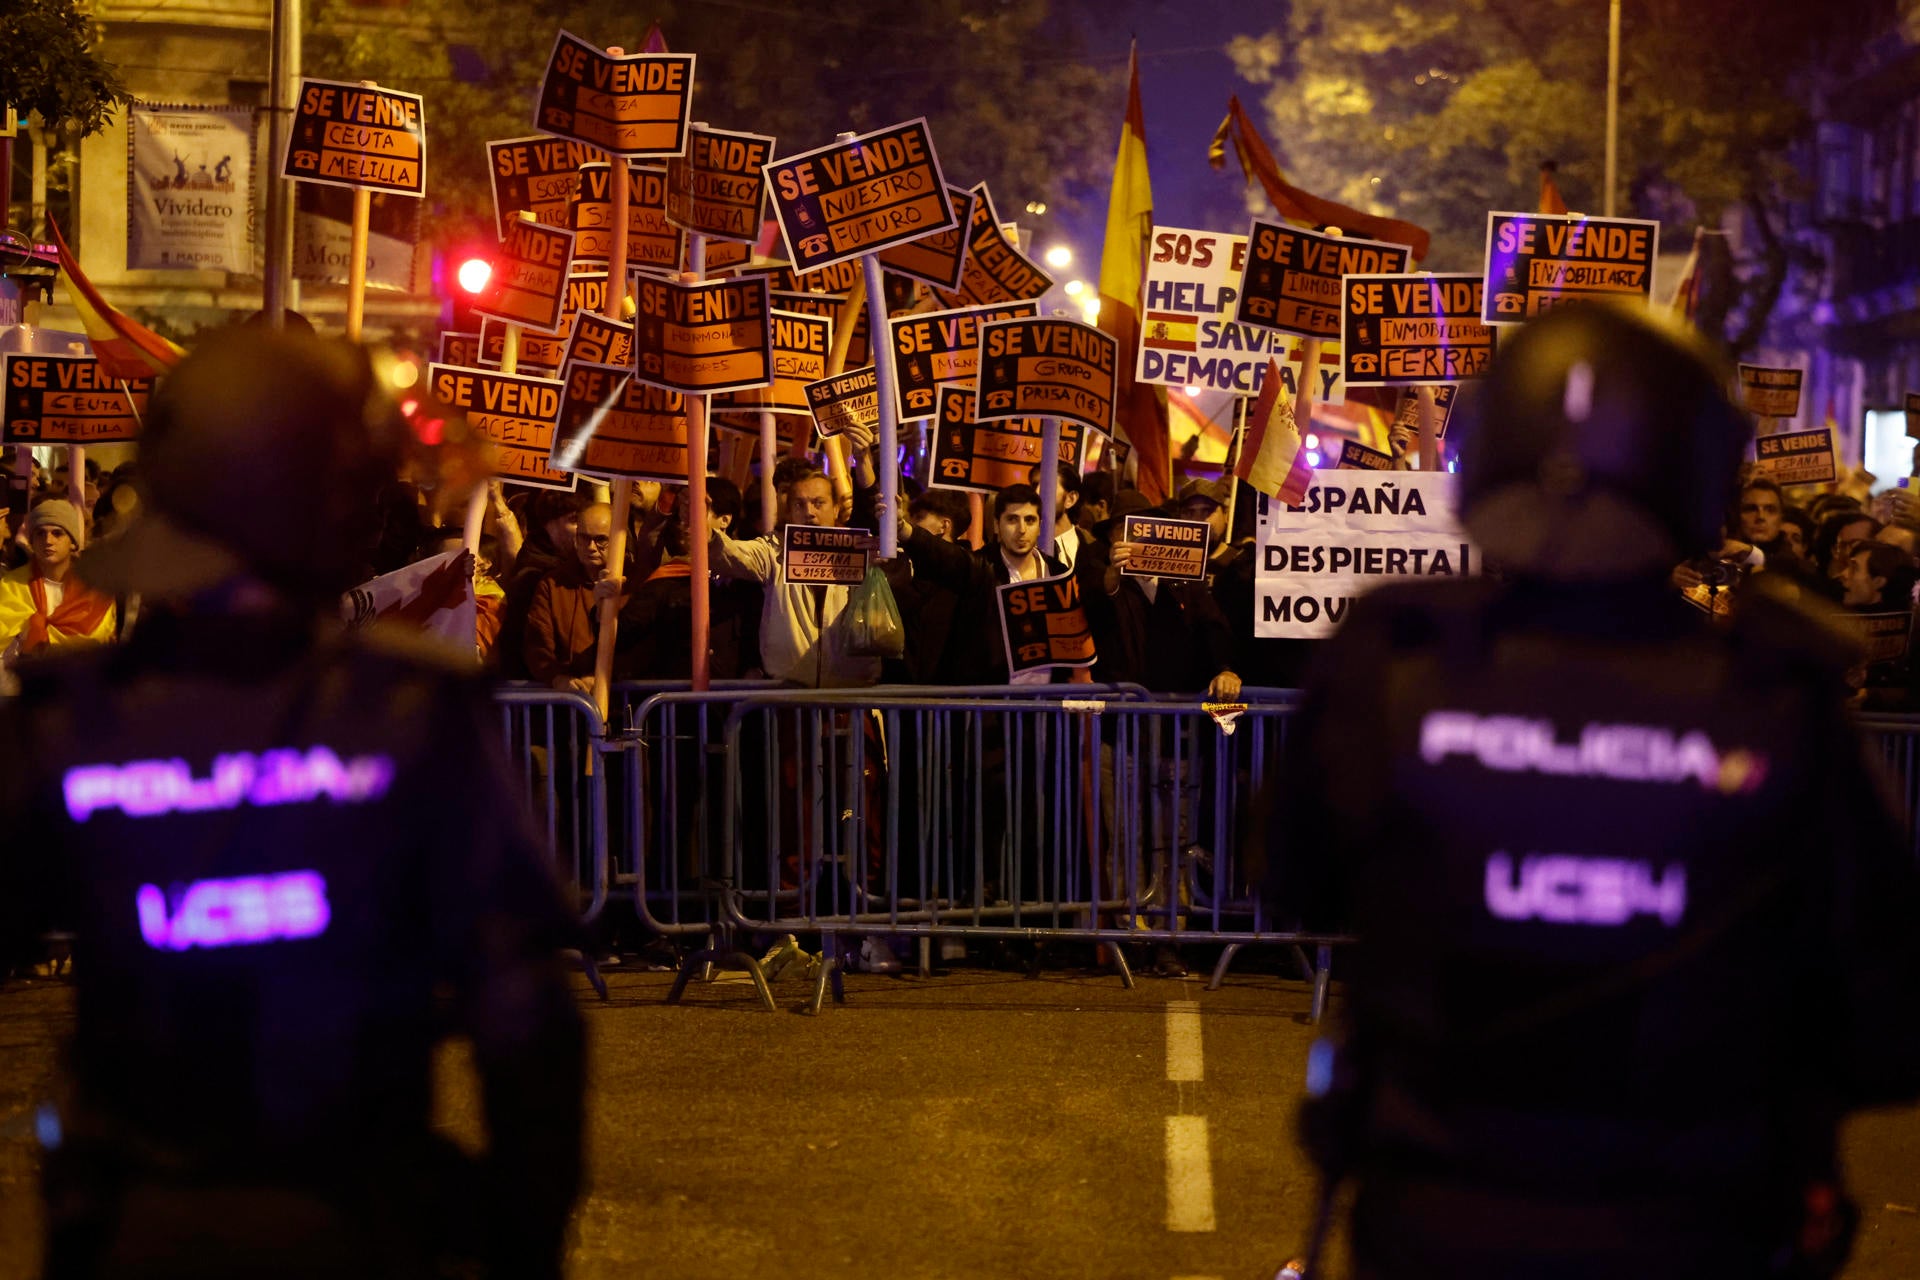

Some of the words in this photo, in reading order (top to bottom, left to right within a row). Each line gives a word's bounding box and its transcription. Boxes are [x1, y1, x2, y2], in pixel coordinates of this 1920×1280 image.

[556, 43, 588, 81] SE
[593, 59, 684, 93] VENDE
[303, 87, 336, 117] SE
[342, 91, 418, 130] VENDE
[329, 125, 395, 149] CEUTA
[328, 156, 410, 184] MELILLA
[497, 147, 530, 177] SE
[534, 141, 611, 173] VEND
[694, 136, 764, 175] ENDE
[777, 162, 819, 201] SE
[820, 130, 925, 186] VENDE
[154, 198, 233, 217] Vividero
[825, 170, 923, 218] NUESTRO
[835, 206, 922, 248] FUTURO
[1497, 222, 1536, 254] SE
[1545, 225, 1647, 261] VENDE
[973, 226, 1046, 300] VENDE
[1153, 233, 1216, 268] SOS
[1256, 229, 1294, 265] SE
[1302, 239, 1400, 276] VENDE
[642, 282, 667, 318] SE
[672, 285, 760, 323] VENDE
[1147, 280, 1237, 313] HELP
[1350, 284, 1383, 315] SE
[1391, 284, 1484, 314] VENDE
[1294, 305, 1339, 329] FER
[899, 323, 934, 355] SE
[988, 327, 1023, 357] SE
[1032, 325, 1113, 373] VENDE
[12, 361, 48, 388] SE
[1034, 360, 1092, 380] GRUPO
[1143, 349, 1341, 401] DEMOCRAY
[437, 374, 473, 407] SE
[482, 380, 558, 418] VEND
[571, 370, 603, 403] SE
[812, 385, 831, 401] SE
[831, 372, 876, 395] VENDE
[1022, 386, 1070, 401] PRISA
[51, 395, 122, 411] CEUTA
[946, 394, 976, 424] SE
[476, 416, 555, 446] ACEIT
[1761, 441, 1779, 454] SE
[1781, 434, 1827, 451] VENDE
[1346, 446, 1361, 460] SE
[793, 531, 811, 545] SE
[1133, 523, 1152, 537] SE
[1154, 525, 1202, 541] VENDE
[1009, 586, 1048, 615] SE
[1263, 595, 1349, 623] MOV
